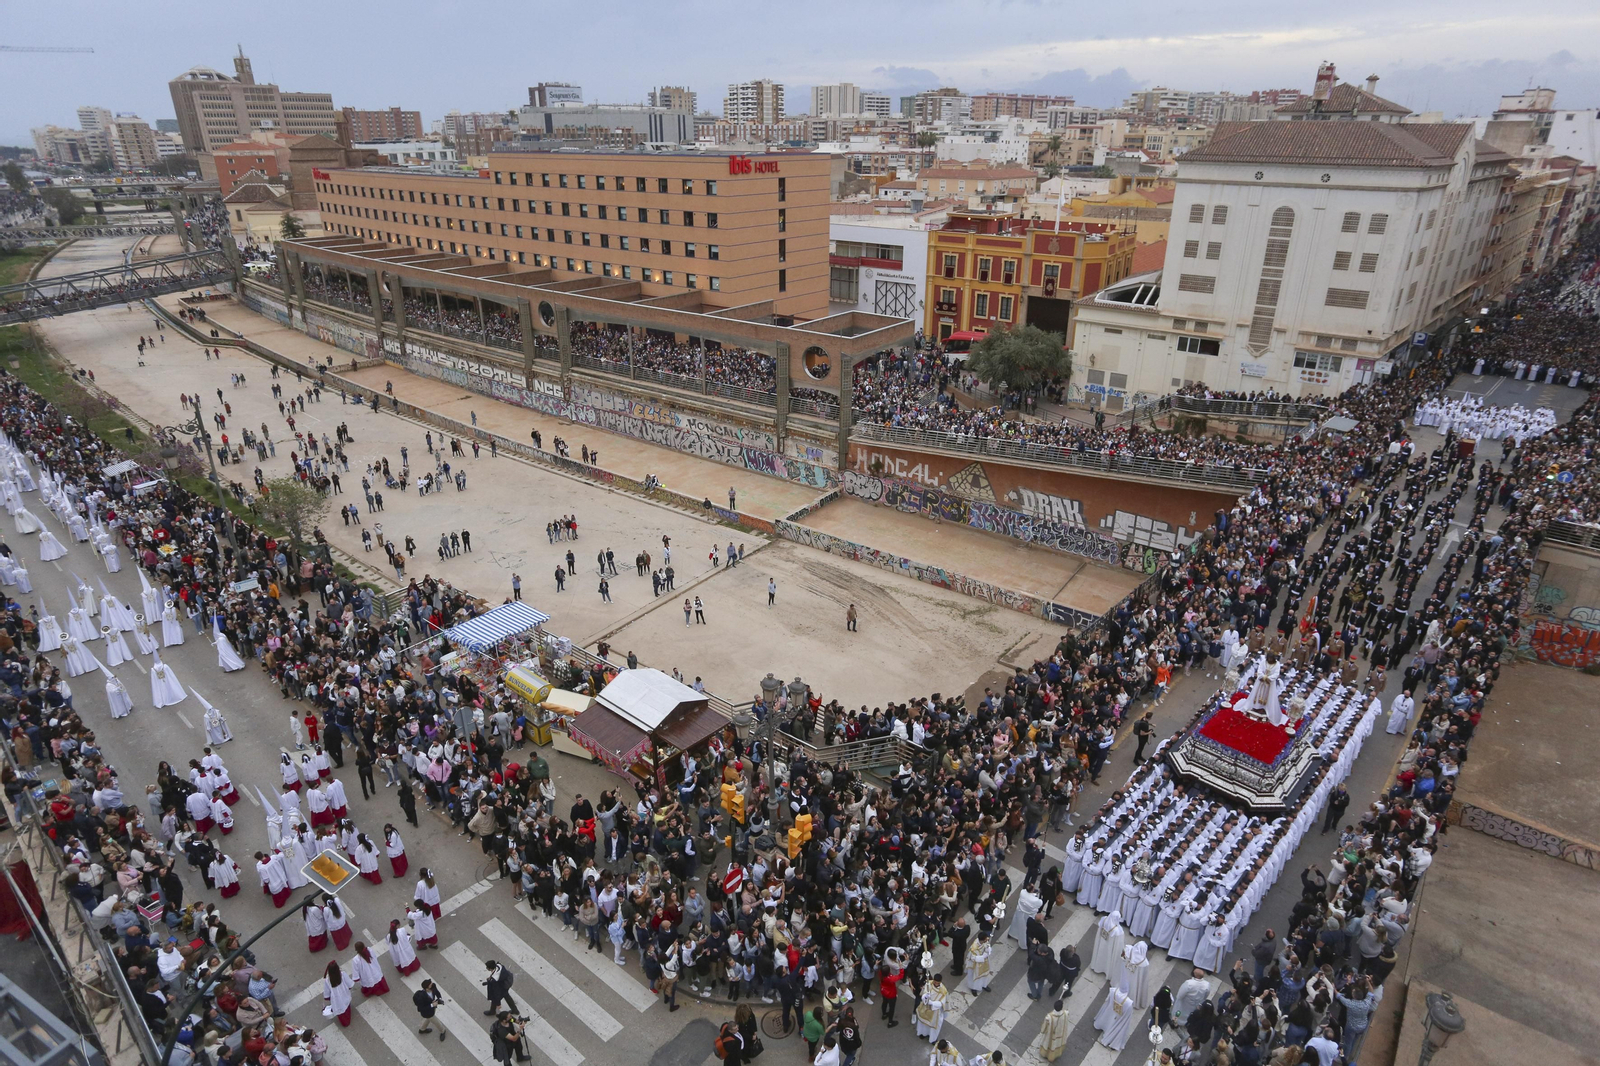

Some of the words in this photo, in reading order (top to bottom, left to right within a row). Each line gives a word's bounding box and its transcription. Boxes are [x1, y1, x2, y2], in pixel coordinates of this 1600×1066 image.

[729, 155, 752, 175] ibis
[754, 161, 781, 174] HOTEL
[1414, 332, 1426, 343] P
